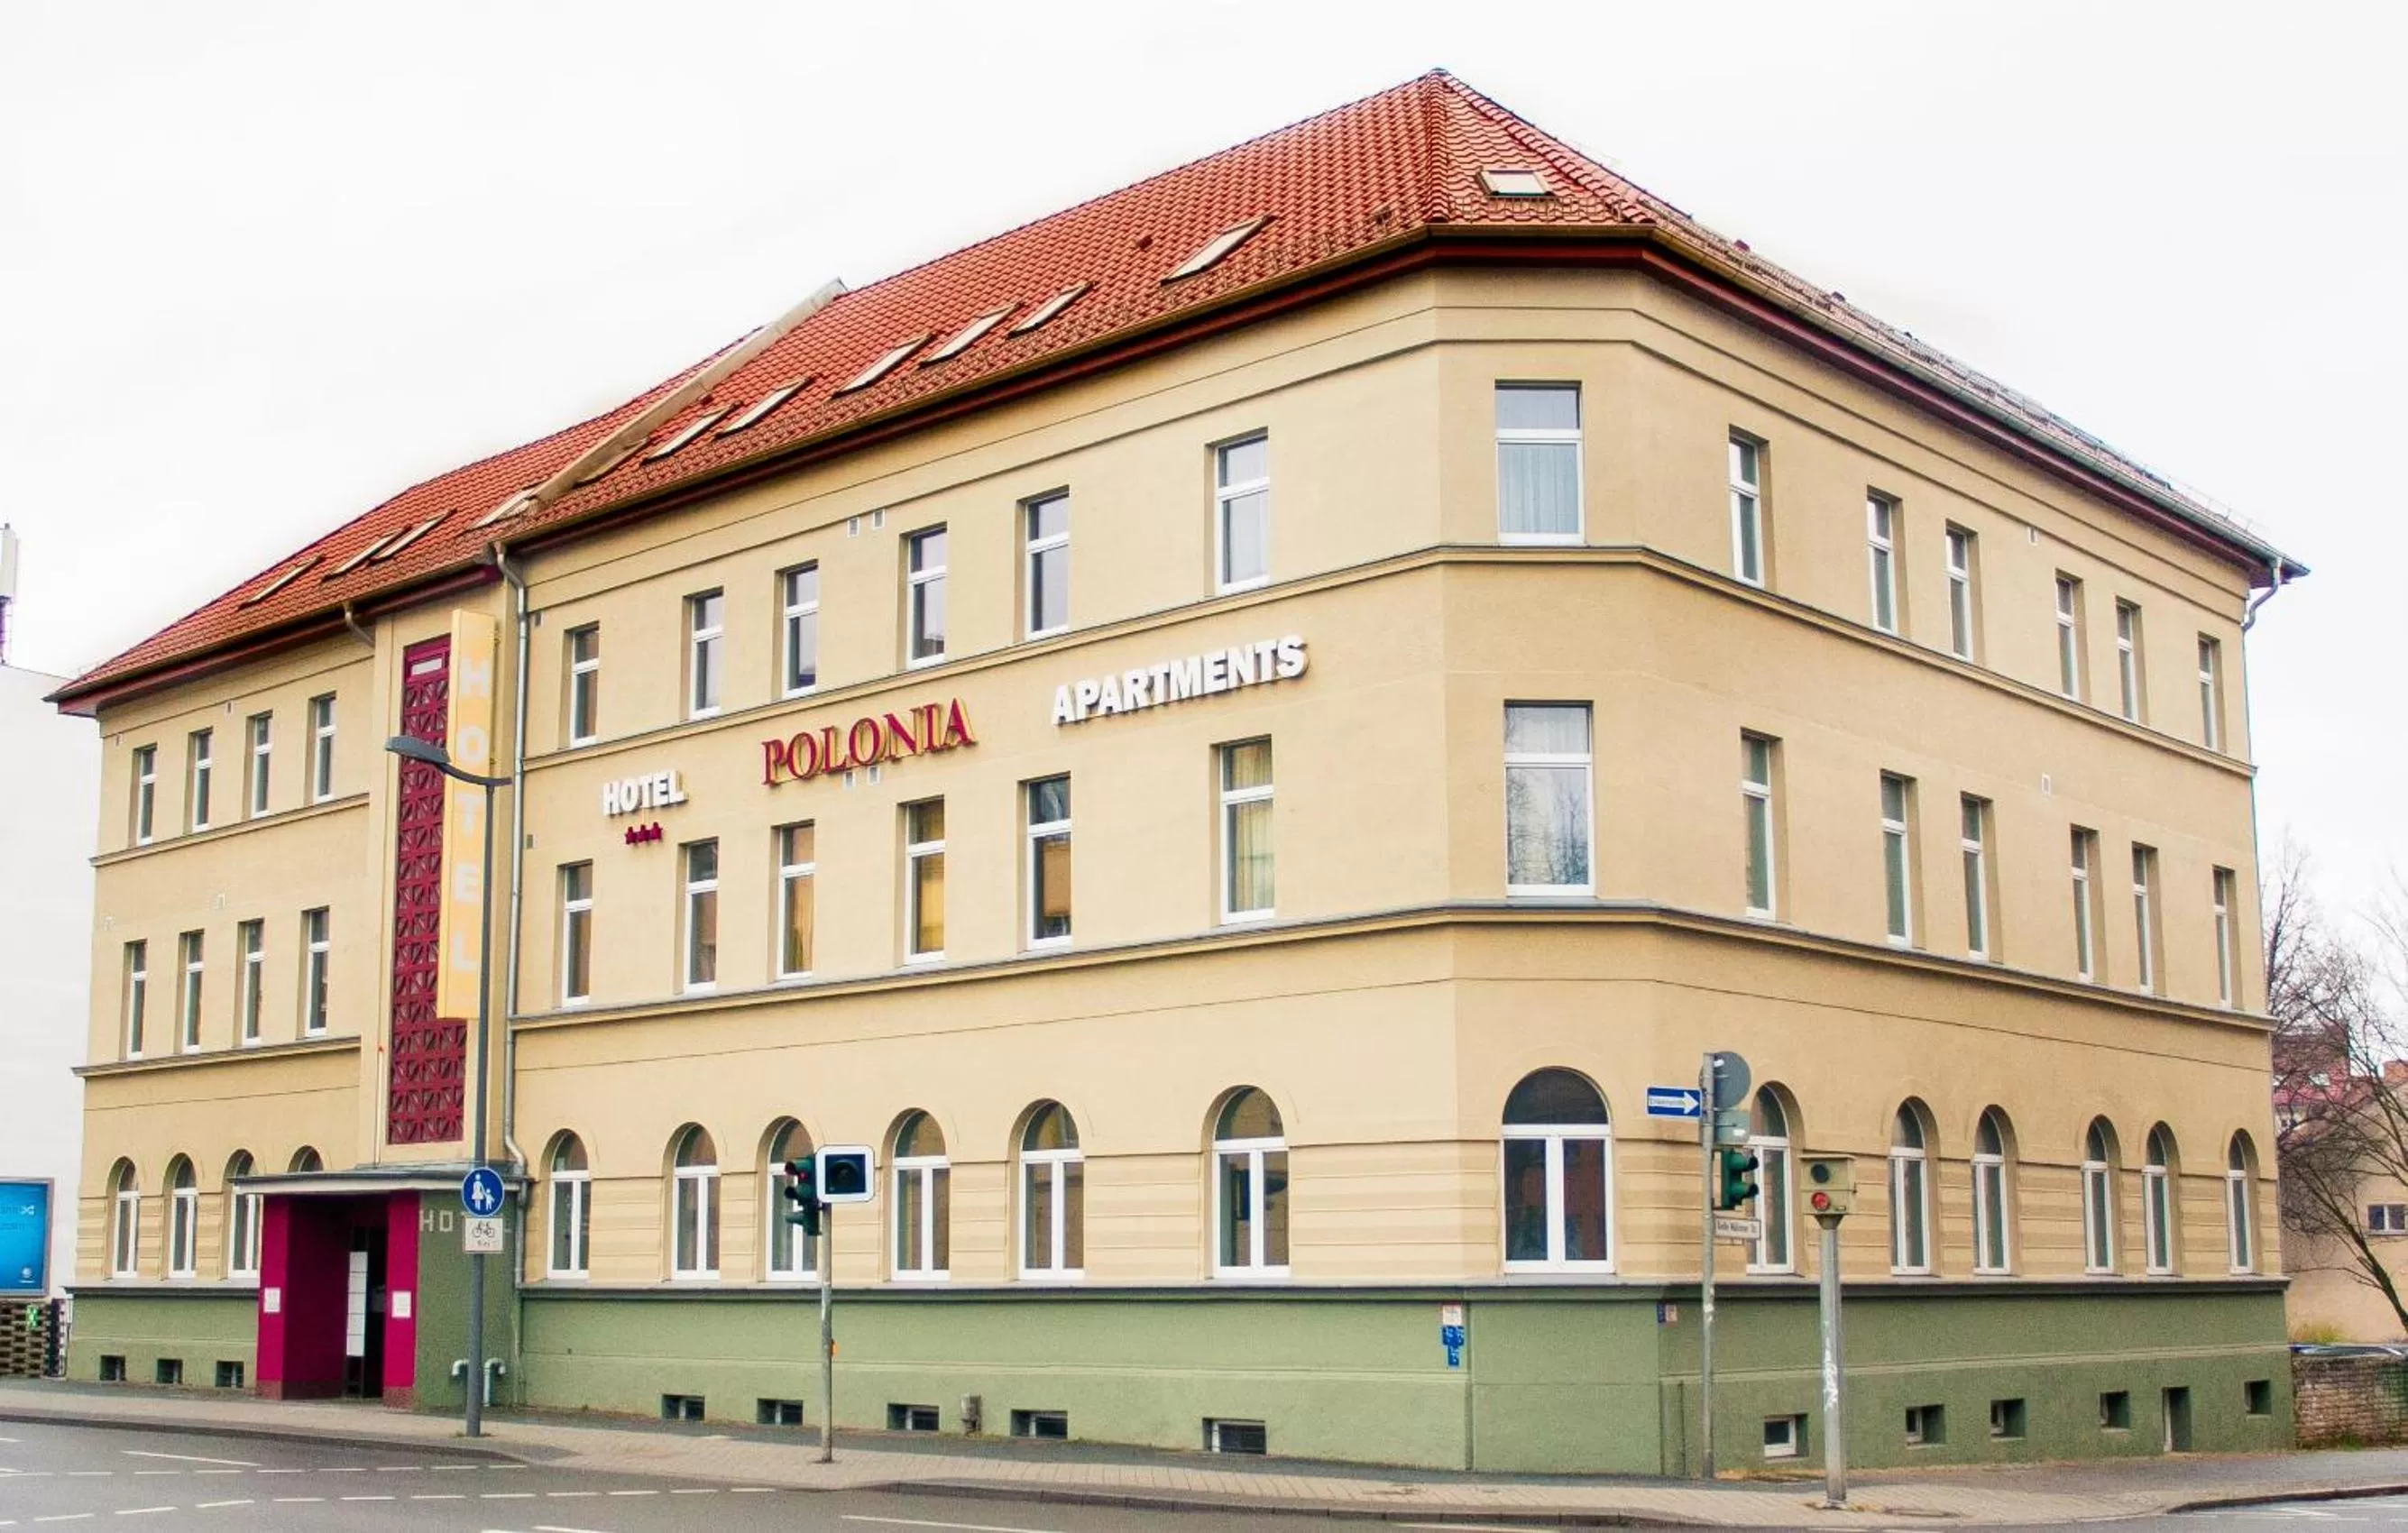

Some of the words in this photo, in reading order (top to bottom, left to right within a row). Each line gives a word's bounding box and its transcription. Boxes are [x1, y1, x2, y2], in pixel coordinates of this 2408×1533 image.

[1051, 634, 1307, 725] APARTMENTS
[761, 697, 976, 786] POLONIA
[454, 658, 489, 971] HOTEL
[602, 769, 688, 816] HOTEL
